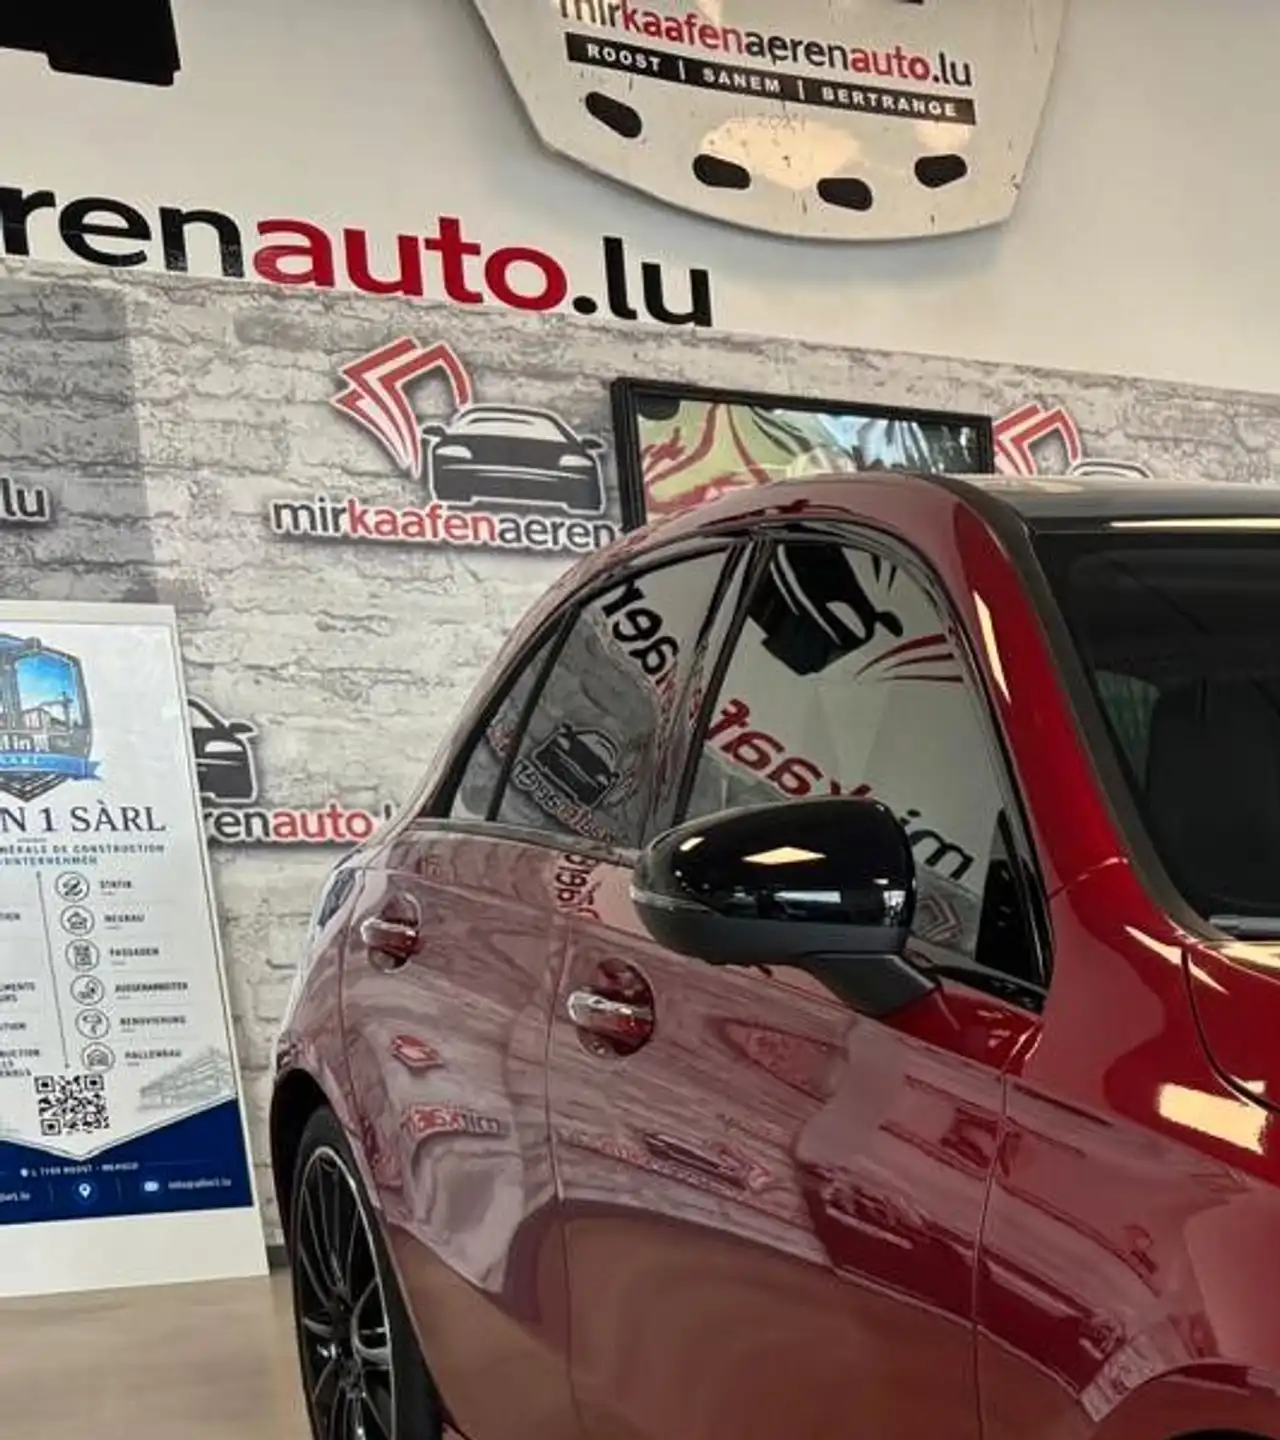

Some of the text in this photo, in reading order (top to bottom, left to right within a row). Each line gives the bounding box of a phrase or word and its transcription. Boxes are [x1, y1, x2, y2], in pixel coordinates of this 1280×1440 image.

[586, 43, 957, 117] ROOST SANEM BERTRANGE
[0, 186, 712, 328] renauto.lu
[39, 806, 58, 832] 1
[70, 799, 167, 832] SÀRL
[203, 803, 391, 838] enauto
